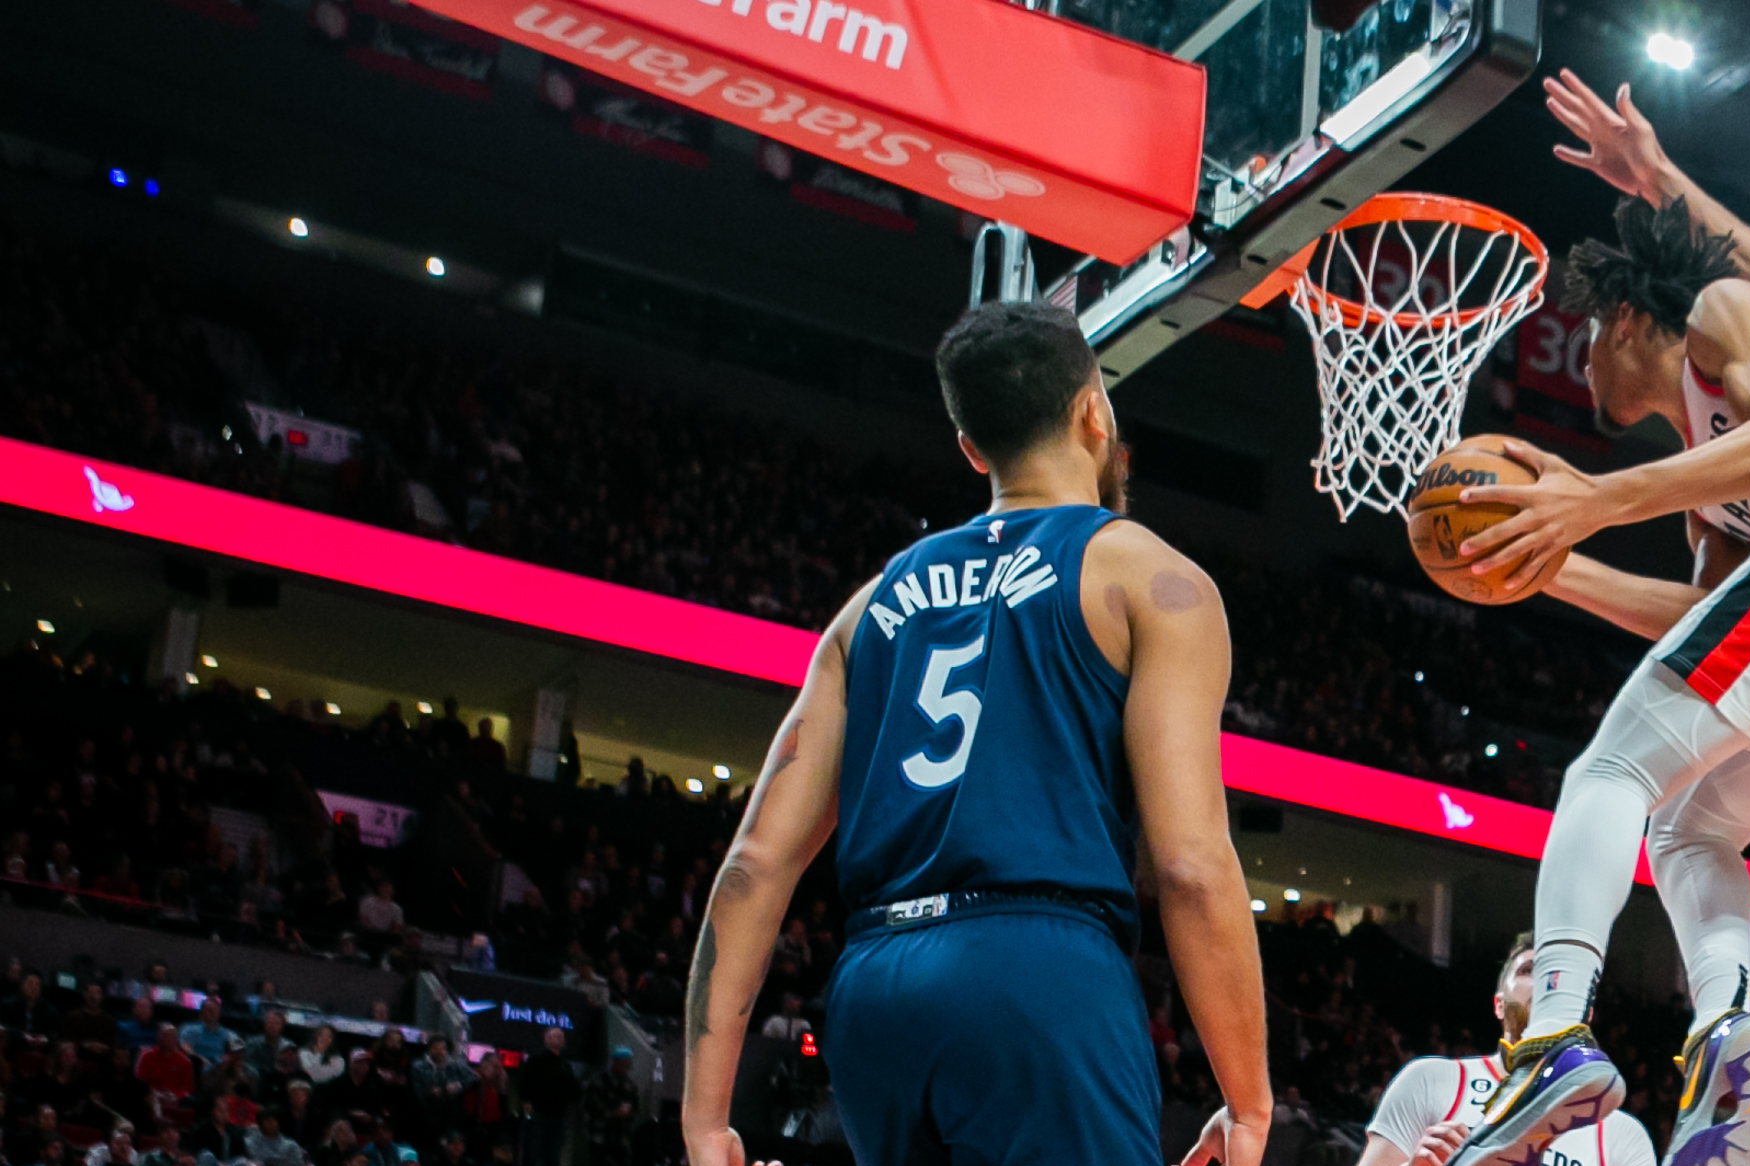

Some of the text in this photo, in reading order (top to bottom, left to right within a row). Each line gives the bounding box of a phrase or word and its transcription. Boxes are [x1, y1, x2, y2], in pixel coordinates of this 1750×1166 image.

[901, 632, 987, 789] 5
[501, 1001, 532, 1022] Just
[534, 1006, 556, 1026] do
